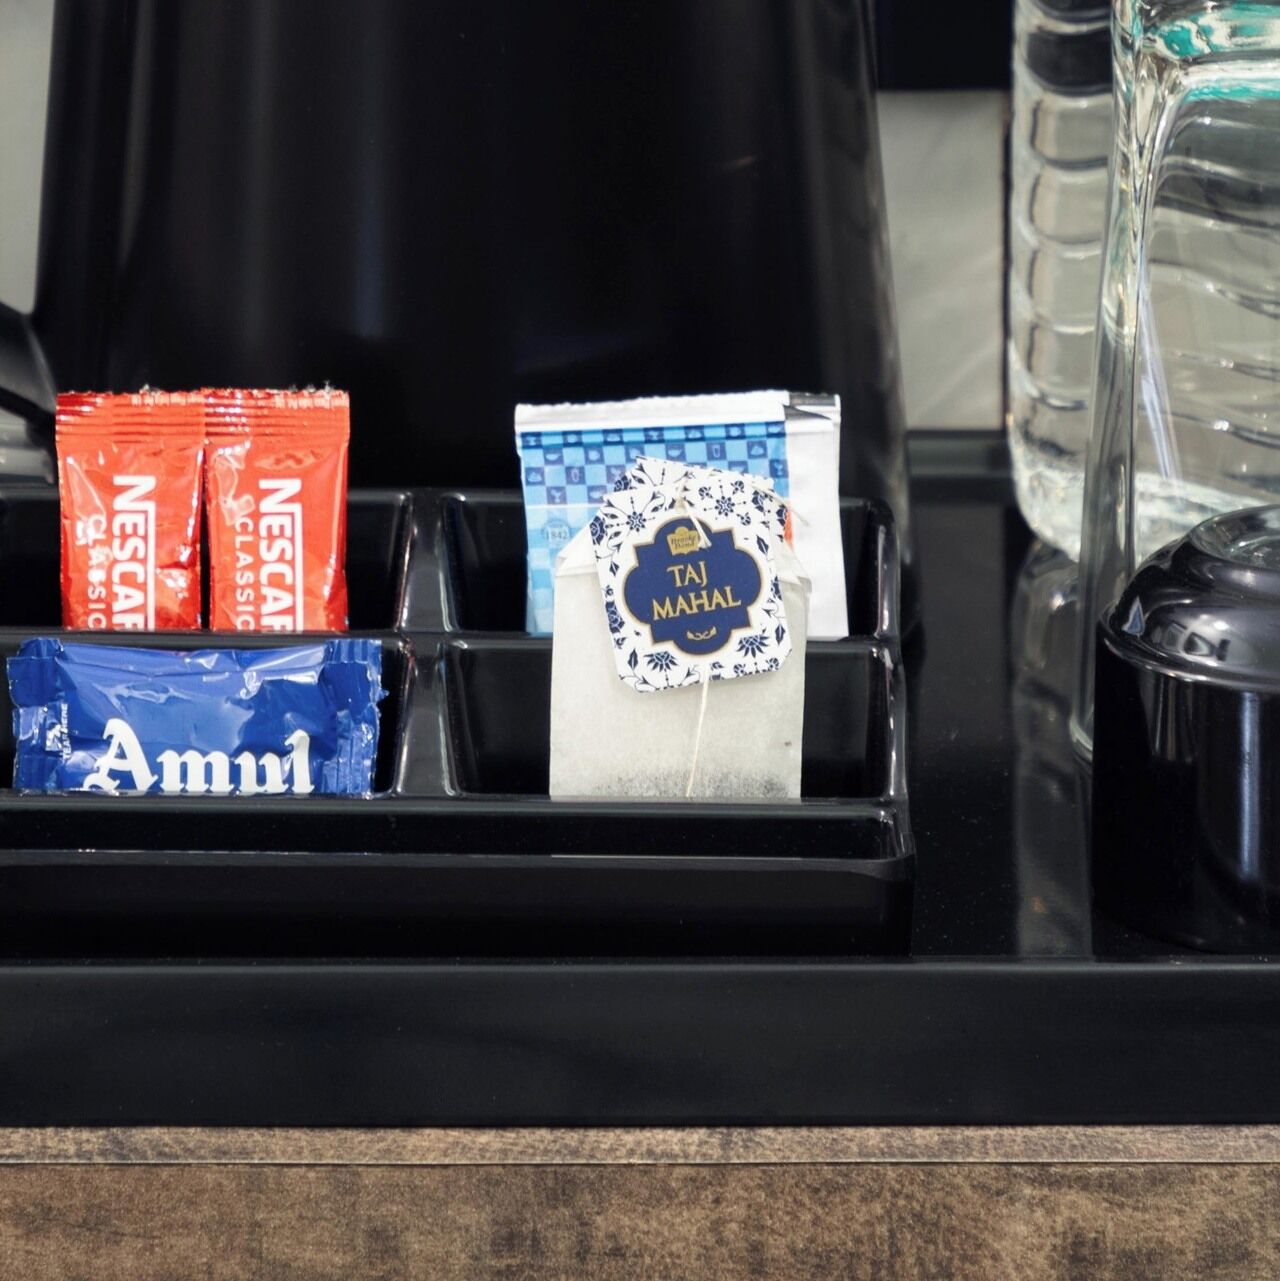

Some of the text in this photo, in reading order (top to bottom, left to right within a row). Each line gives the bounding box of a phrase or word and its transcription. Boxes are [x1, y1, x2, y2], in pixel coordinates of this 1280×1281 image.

[234, 517, 255, 631] CLASSIC
[666, 561, 708, 589] TAJ
[651, 585, 742, 621] MAHAL
[83, 718, 316, 794] Amul
